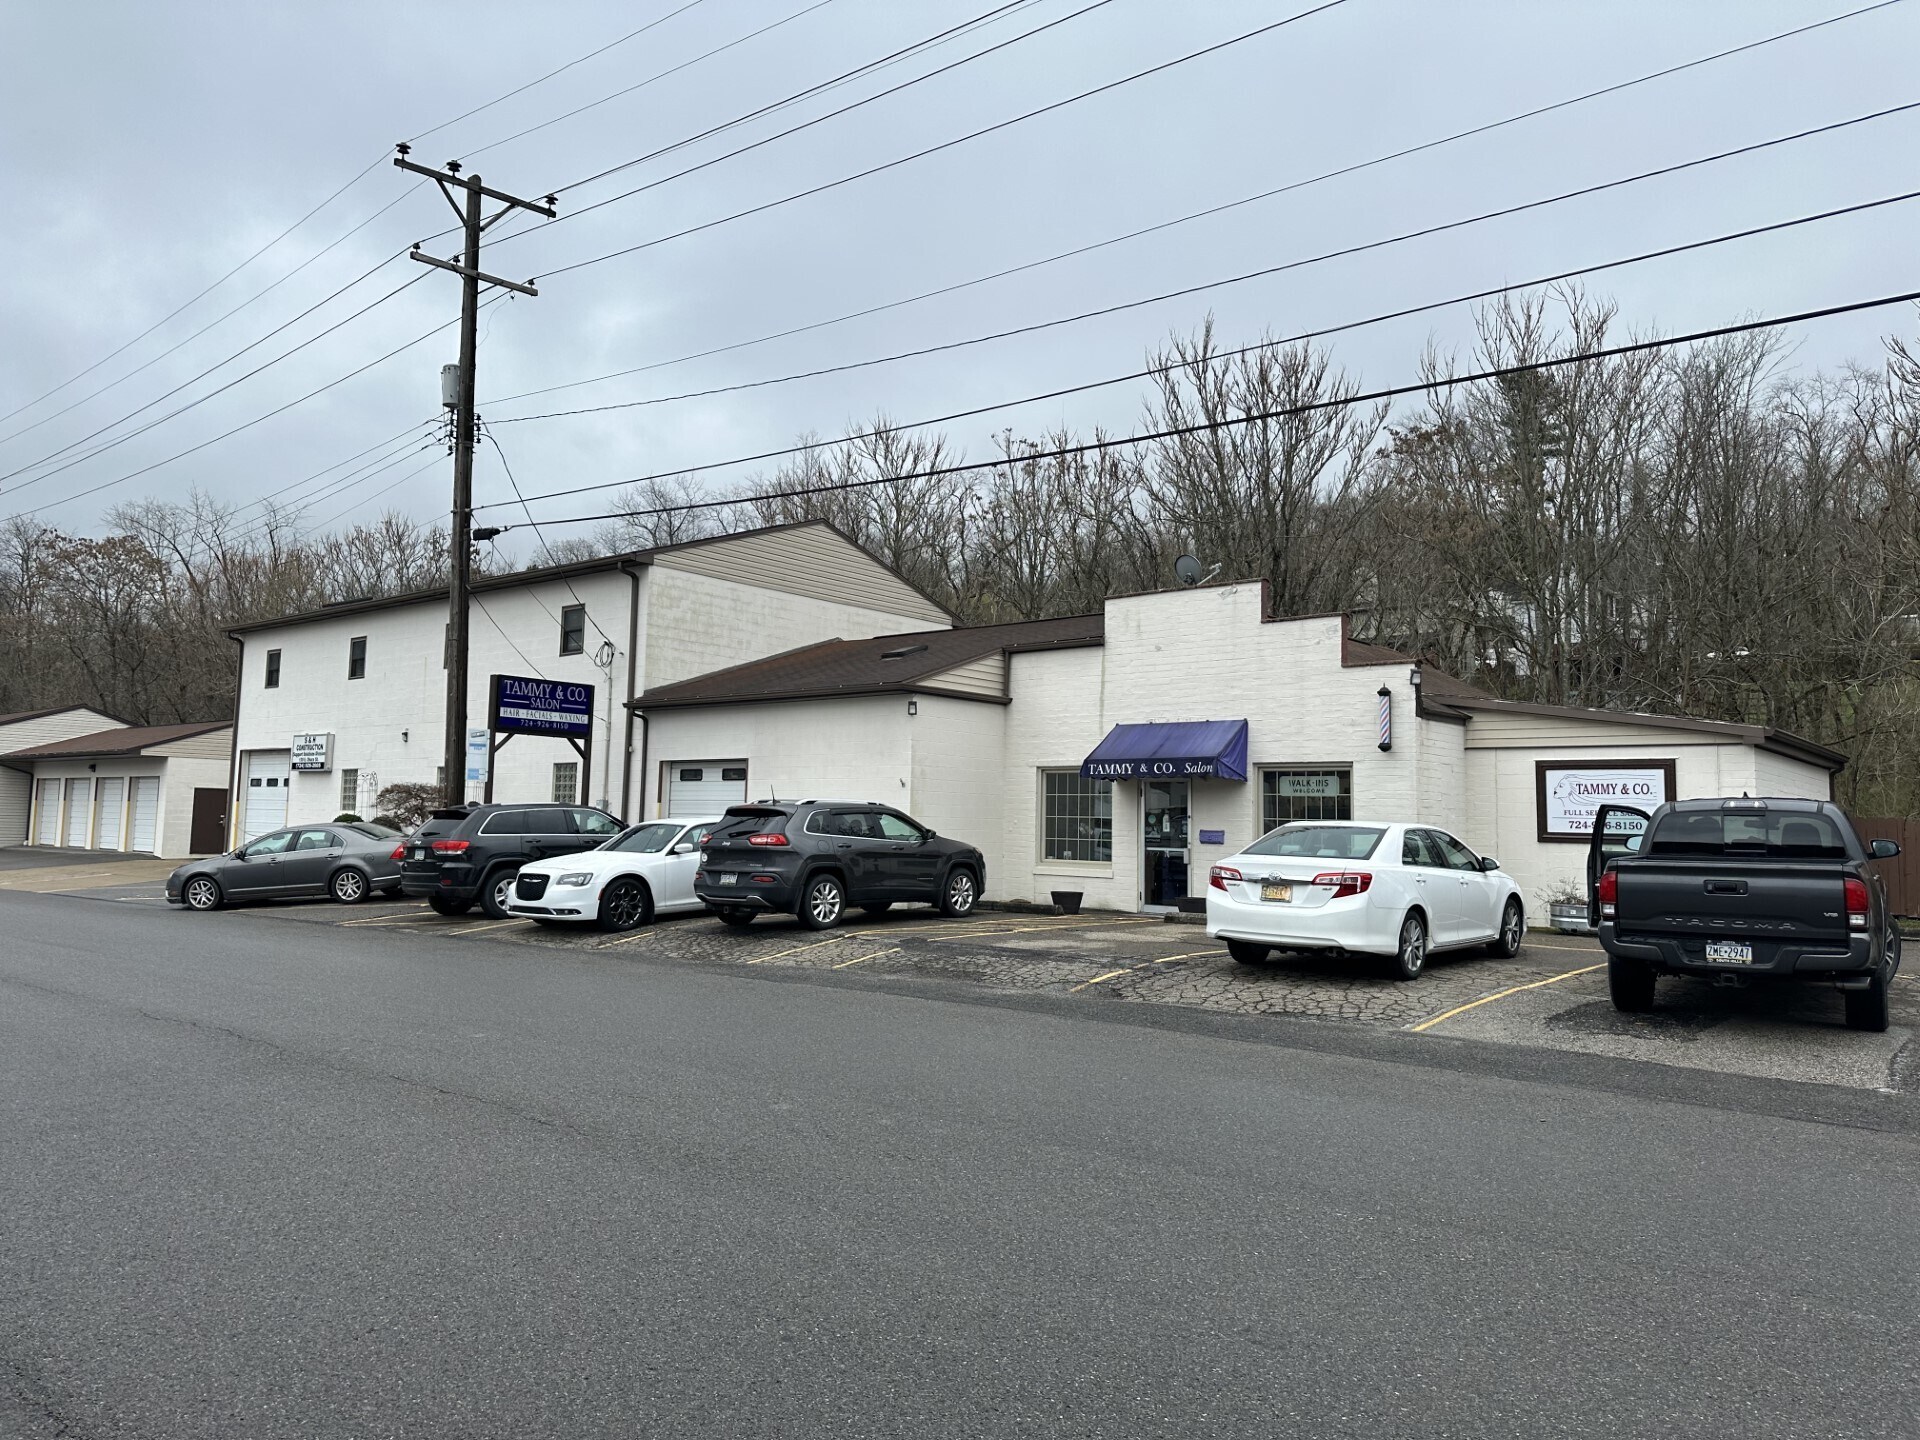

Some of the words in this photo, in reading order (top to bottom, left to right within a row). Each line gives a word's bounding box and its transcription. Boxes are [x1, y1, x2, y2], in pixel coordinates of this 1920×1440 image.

[504, 680, 553, 698] TAMMY
[555, 685, 565, 700] &
[567, 687, 587, 702] CO.
[530, 697, 560, 710] SALON
[503, 709, 520, 717] HAIR
[526, 710, 553, 720] FACIALS
[558, 714, 586, 722] WAXING
[520, 720, 569, 729] 724-926-8150
[1088, 764, 1134, 774] TAMMY
[1140, 763, 1148, 773] &
[1154, 762, 1176, 774] CO.
[1184, 762, 1213, 774] Salon
[1576, 783, 1618, 795] TAMMY
[1620, 783, 1630, 795] &
[1632, 783, 1653, 795] CO.
[1568, 820, 1642, 830] 724-96-8150
[1665, 917, 1796, 930] TACOMA
